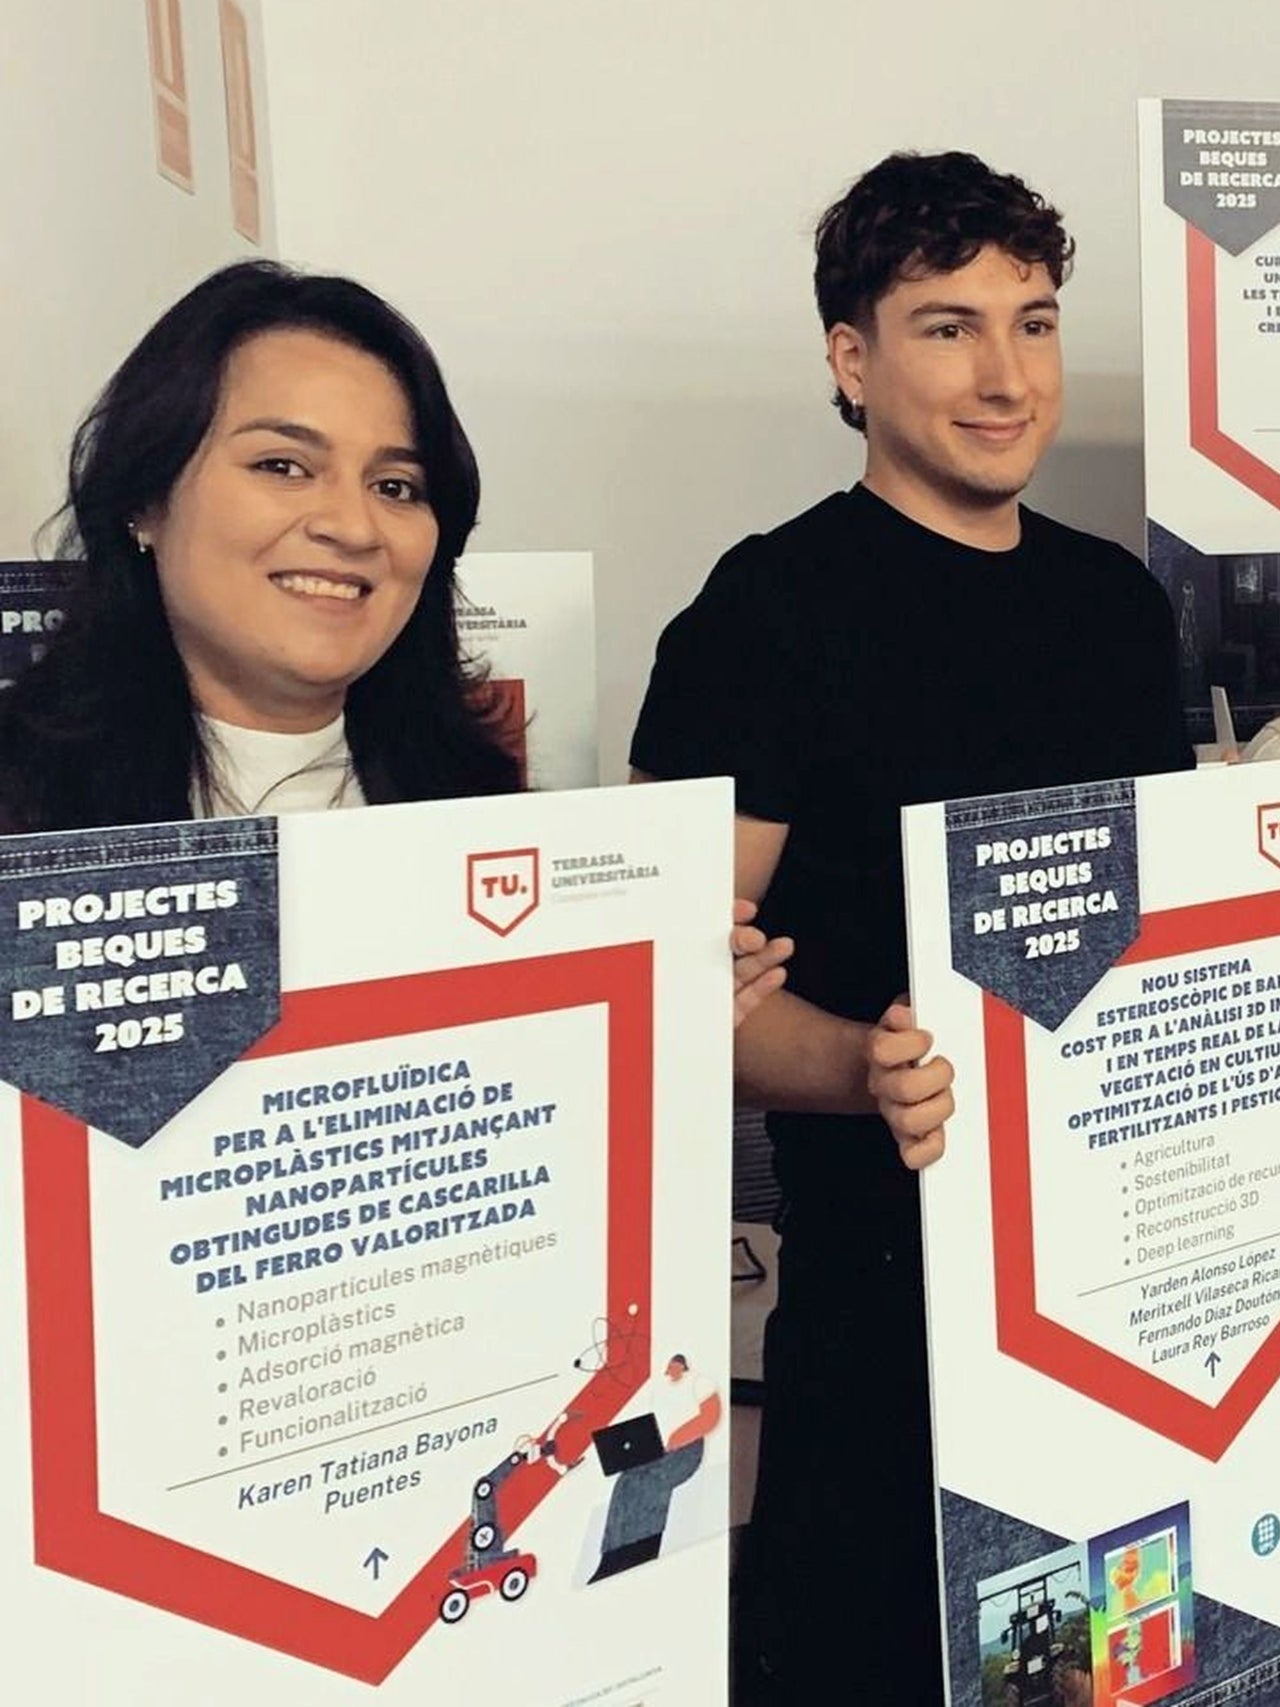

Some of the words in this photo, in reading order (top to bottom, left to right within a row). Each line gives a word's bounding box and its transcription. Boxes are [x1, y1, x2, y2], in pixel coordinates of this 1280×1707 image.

[1180, 171, 1203, 186] DE
[1199, 150, 1266, 168] BEQUES
[1216, 193, 1256, 207] 2025
[551, 852, 624, 871] TERRASSA
[975, 826, 1111, 866] PROJECTES
[999, 861, 1092, 896] BEQUES
[18, 879, 238, 929] PROJECTES
[973, 907, 1006, 934] DE
[1011, 889, 1118, 928] RECERCA
[55, 925, 206, 969] BEQUES
[1025, 928, 1080, 959] 2025
[11, 985, 65, 1020] DE
[74, 962, 247, 1011] RECERCA
[1141, 972, 1178, 994] NOU
[1183, 958, 1251, 984] SISTEMA
[1096, 985, 1227, 1027] ESTEREOSCÒPIC
[1231, 980, 1251, 998] DE
[94, 1012, 184, 1052] 2025
[262, 1059, 470, 1114] MICROFLUÏDICA
[1099, 1059, 1195, 1097] VEGETACIÓ
[1199, 1056, 1220, 1074] EN
[214, 1128, 266, 1156] PER
[274, 1123, 294, 1145] A
[303, 1084, 475, 1140] L'ELIMINACIÓ
[482, 1081, 512, 1105] DE
[1088, 1103, 1217, 1149] FERTILITZANTS
[1221, 1100, 1226, 1115] I
[160, 1137, 383, 1200] MICROPLÀSTICS
[391, 1103, 556, 1154] MITJANÇANT
[1133, 1134, 1214, 1167] Agricultura
[1134, 1152, 1229, 1191] Sostenibilitat
[246, 1148, 487, 1216] NANOPARTÍCULES
[170, 1208, 350, 1264] OBTINGUDES
[358, 1199, 390, 1224] DE
[398, 1165, 550, 1214] CASCARILLA
[196, 1264, 247, 1293] DEL
[255, 1242, 343, 1280] FERRO
[350, 1198, 535, 1256] VALORITZADA
[420, 1232, 557, 1278] magnètiques
[1136, 1242, 1174, 1263] Deep
[1177, 1224, 1234, 1251] learning
[1129, 1292, 1191, 1326] Meritxell
[1194, 1278, 1249, 1304] Vilaseca
[238, 1303, 395, 1356] Microplàstics
[238, 1343, 342, 1388] Adsorció
[348, 1315, 464, 1359] magnètica
[1151, 1341, 1189, 1364] Laura
[1192, 1332, 1217, 1349] Rey
[1220, 1314, 1270, 1341] Barroso
[239, 1365, 376, 1421] Revaloració
[240, 1382, 427, 1453] Funcionalització
[238, 1473, 312, 1509] Karen
[320, 1444, 408, 1483] Tatiana
[415, 1417, 497, 1455] Bayona
[324, 1470, 420, 1514] Puentes
